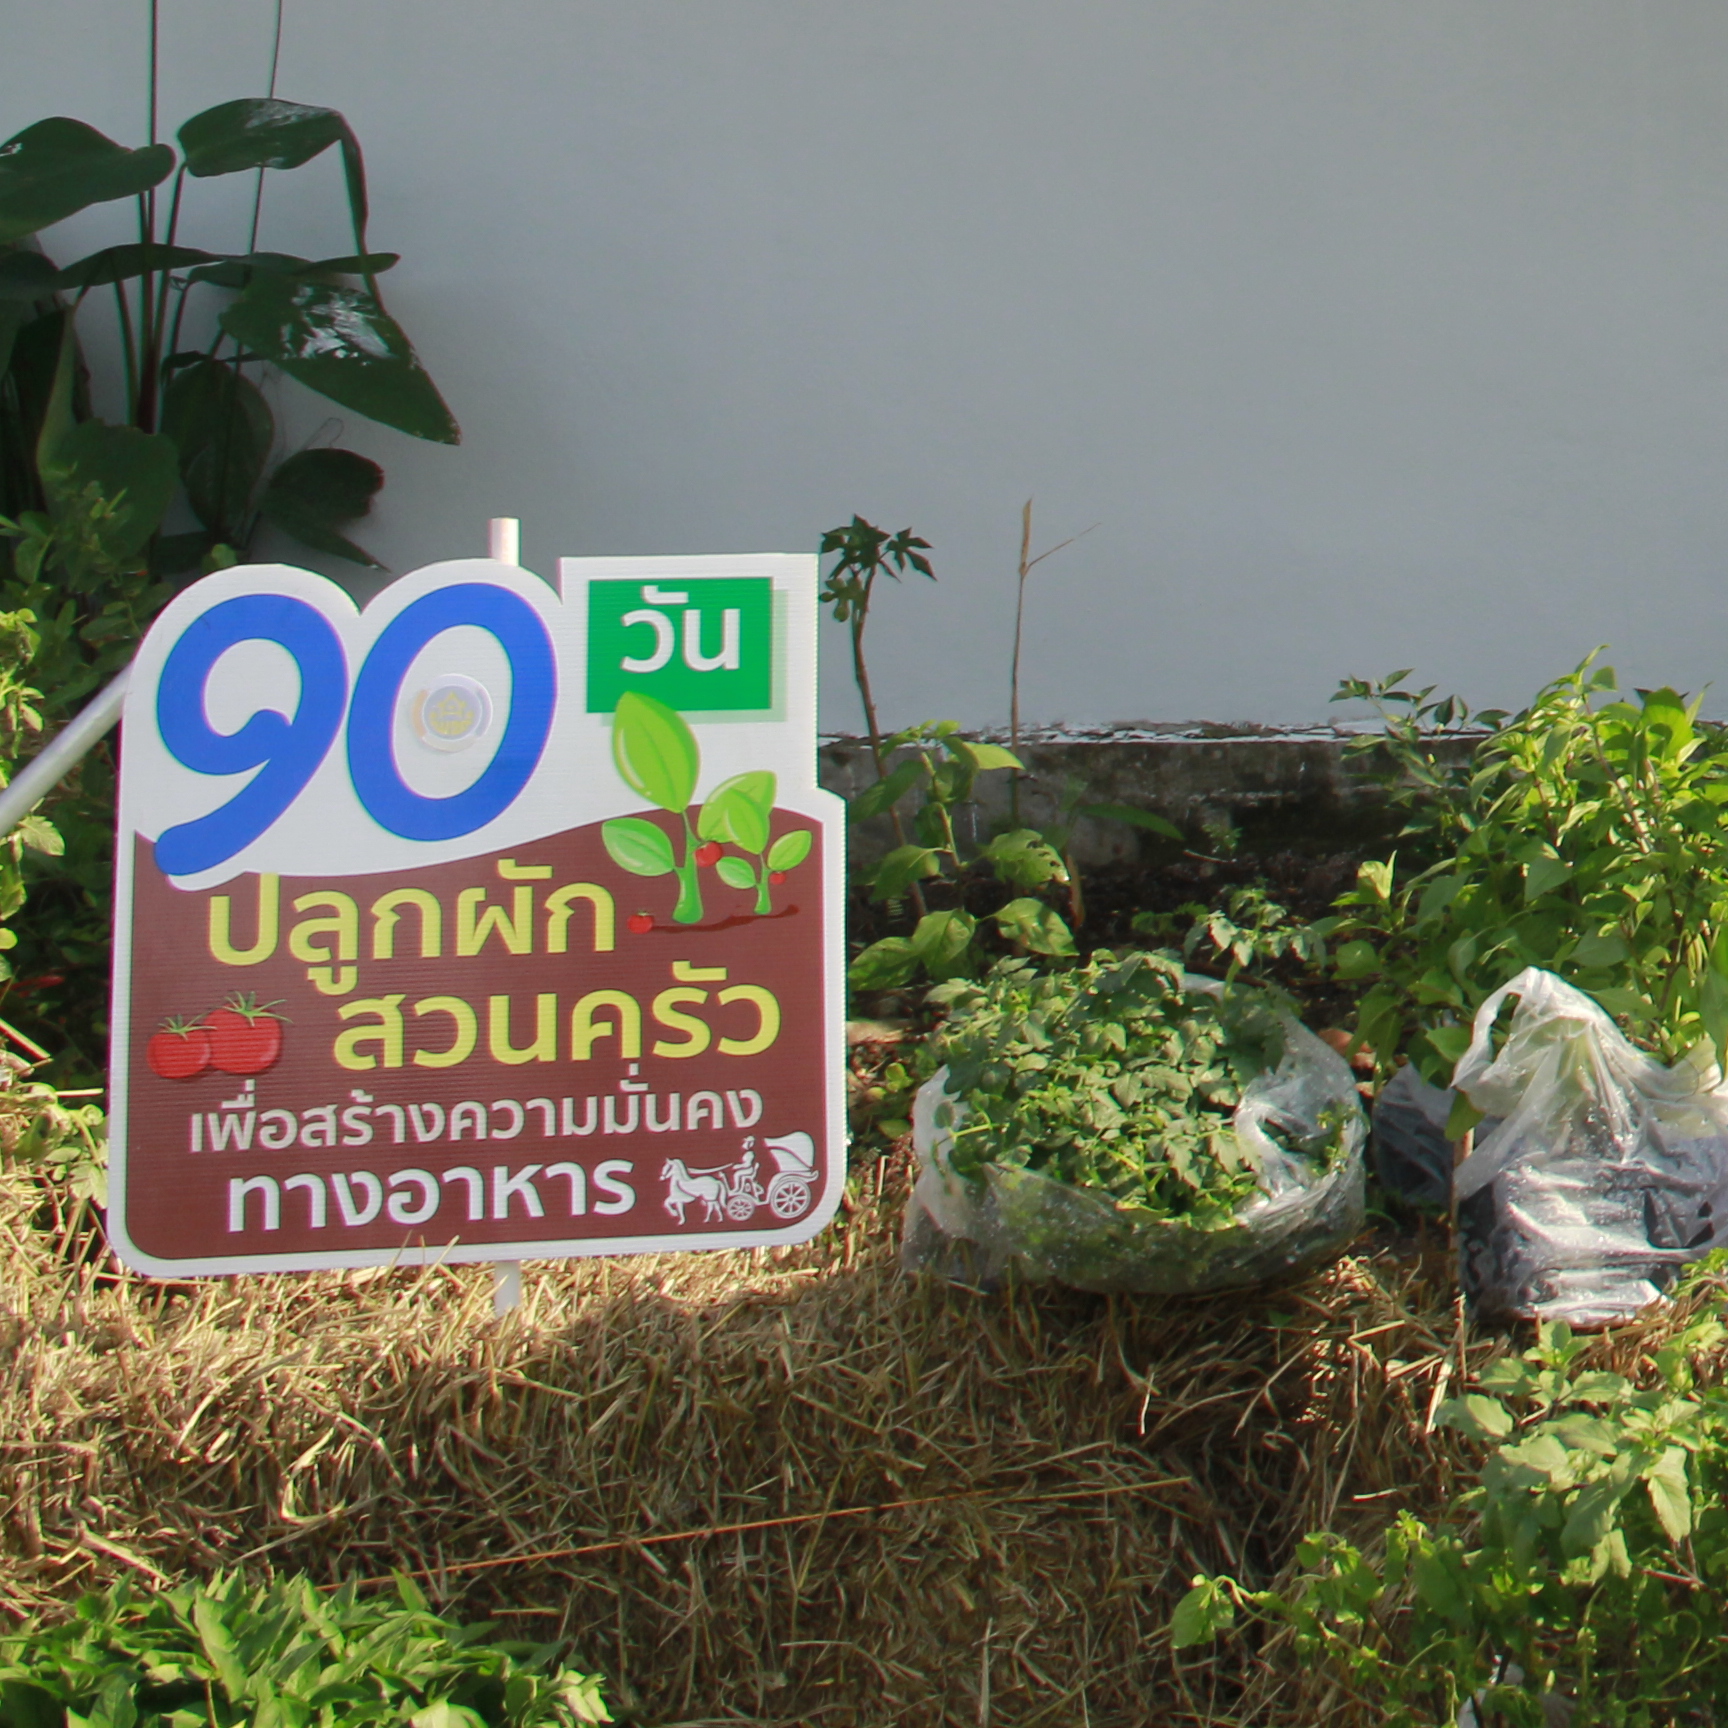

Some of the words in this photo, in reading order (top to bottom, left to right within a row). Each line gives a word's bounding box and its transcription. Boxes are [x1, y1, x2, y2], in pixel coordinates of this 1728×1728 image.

[620, 584, 741, 672] วัน
[208, 858, 616, 995] ปลูกผัก
[333, 960, 781, 1071] สวนครัว
[189, 1064, 763, 1154] เพื่อสร้างความมั่นคง
[227, 1157, 637, 1233] ทางอาหาร
